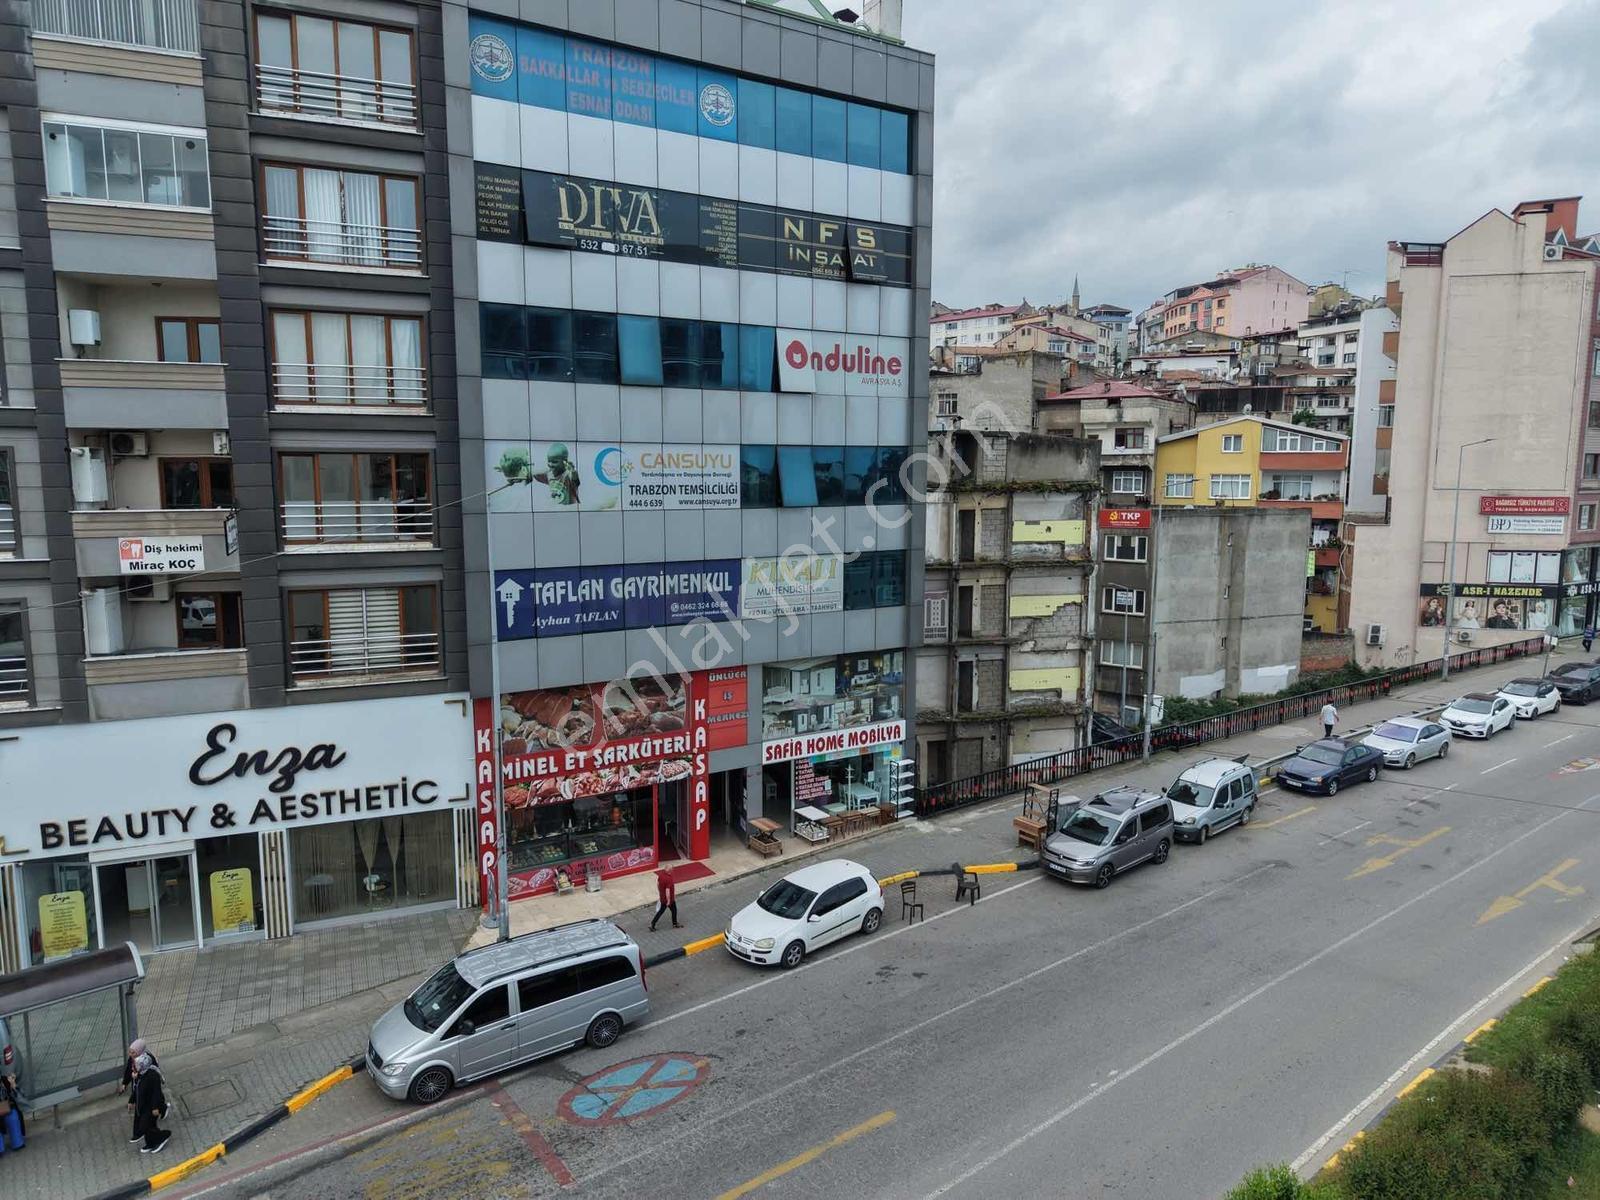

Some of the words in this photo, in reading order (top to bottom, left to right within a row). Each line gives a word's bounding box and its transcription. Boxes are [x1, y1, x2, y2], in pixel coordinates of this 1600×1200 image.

[519, 56, 600, 88] BAKKALLAR
[572, 44, 650, 73] TRABZON
[580, 239, 599, 250] 532
[622, 244, 633, 254] 67
[637, 245, 648, 256] 51
[786, 340, 902, 375] Onduline
[641, 453, 732, 469] CANSUYU
[629, 484, 677, 496] TRABZON
[678, 482, 738, 495] TEMSİLCİLİĞİ
[1121, 512, 1141, 520] TKP
[144, 544, 163, 555] Diş
[165, 543, 202, 553] hekimi
[129, 561, 164, 573] Miraç
[169, 559, 195, 571] KOÇ
[529, 578, 604, 606] TAFLAN
[610, 570, 733, 599] GAYRİMENKUL
[532, 616, 570, 629] Ayhan
[574, 610, 620, 624] TAFLAN
[708, 670, 747, 683] ÜNLÜER
[189, 723, 347, 793] Enza
[565, 750, 587, 771] ET
[593, 731, 691, 769] ŞARKÜTERİ
[765, 739, 802, 762] SAFİR
[806, 733, 844, 755] HOME
[848, 724, 901, 748] MOBİLYA
[694, 699, 706, 831] KASAP
[40, 805, 197, 850] BEAUTY
[210, 803, 236, 829] &
[249, 776, 440, 826] AESTHETİC
[477, 728, 496, 876] KASAP
